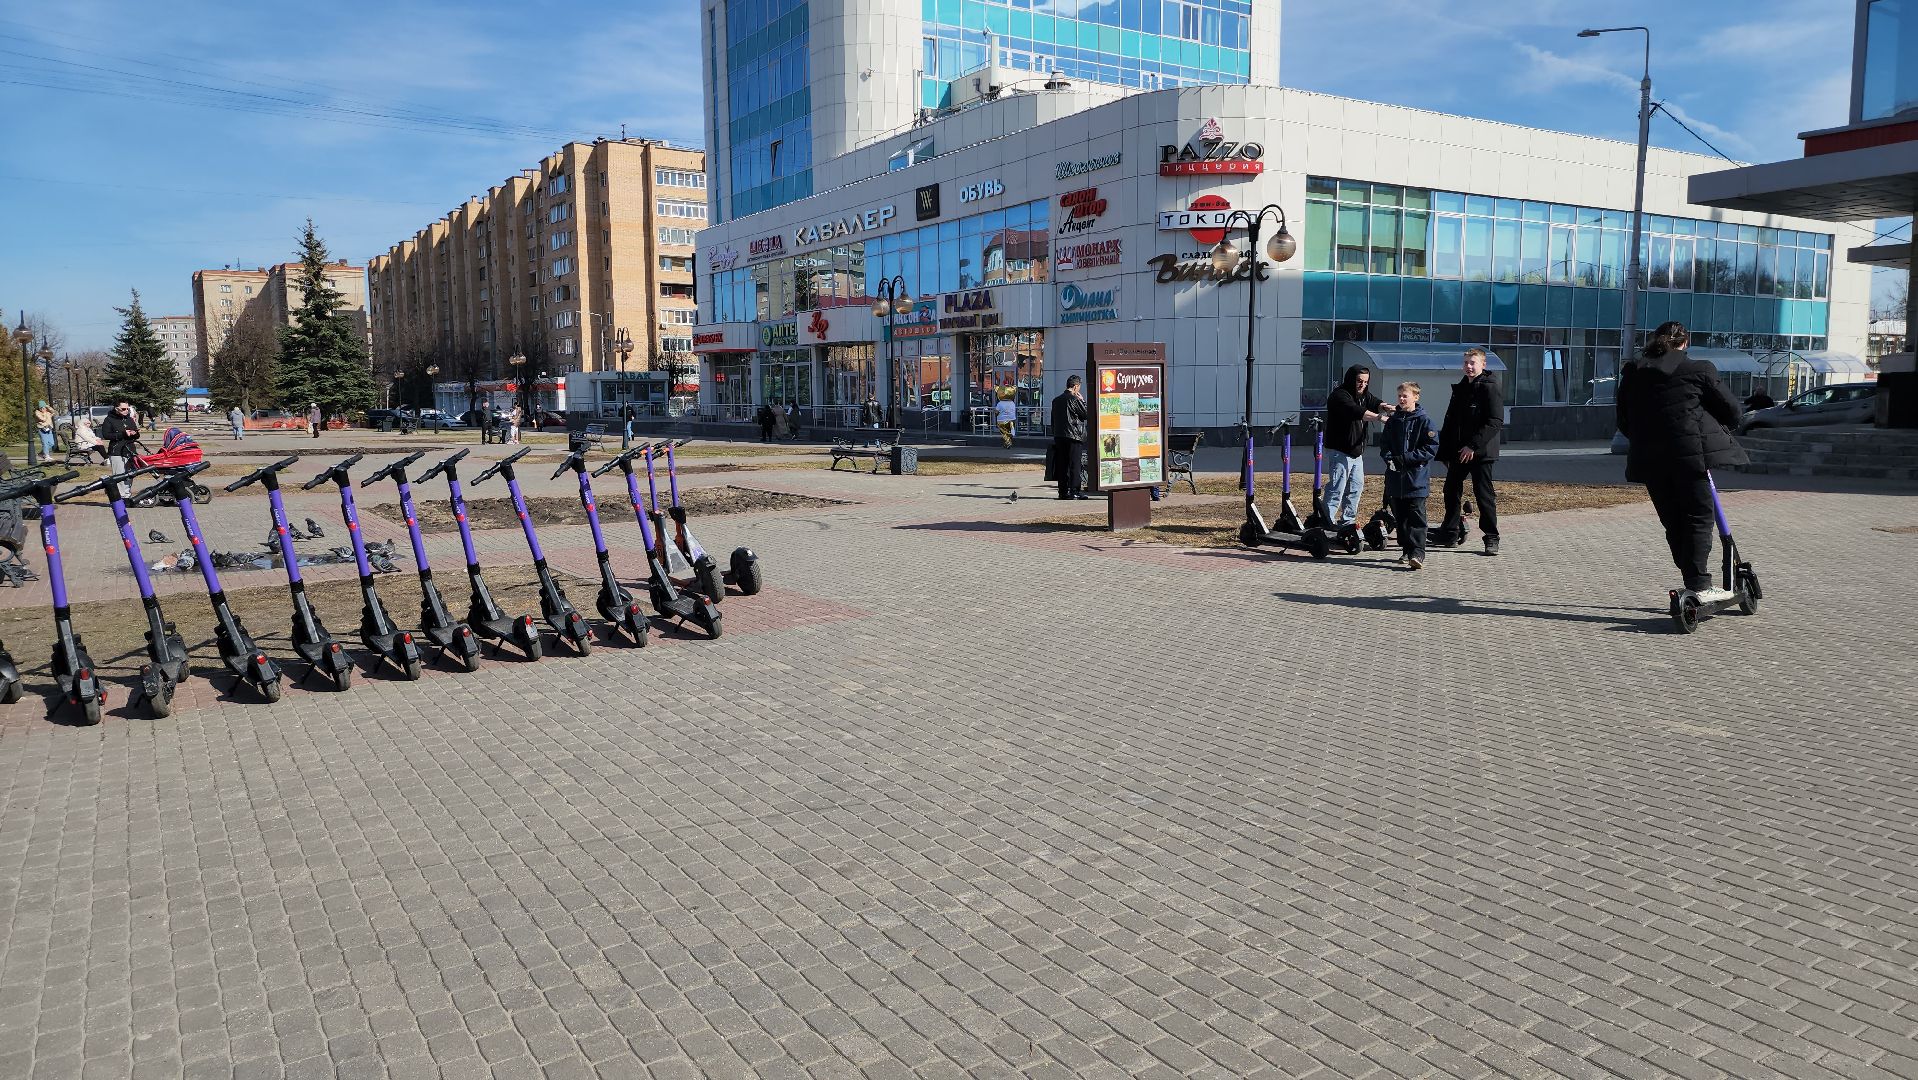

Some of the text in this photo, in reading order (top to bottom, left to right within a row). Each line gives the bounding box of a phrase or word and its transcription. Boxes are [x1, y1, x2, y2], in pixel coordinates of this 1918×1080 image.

[1160, 141, 1264, 162] PAZZO
[960, 179, 1004, 203] ОБУВЬ
[794, 204, 896, 247] КАВАЛЕР
[944, 290, 993, 313] PLAZA
[616, 372, 651, 380] ТАБАК
[1117, 373, 1154, 389] Серпухов
